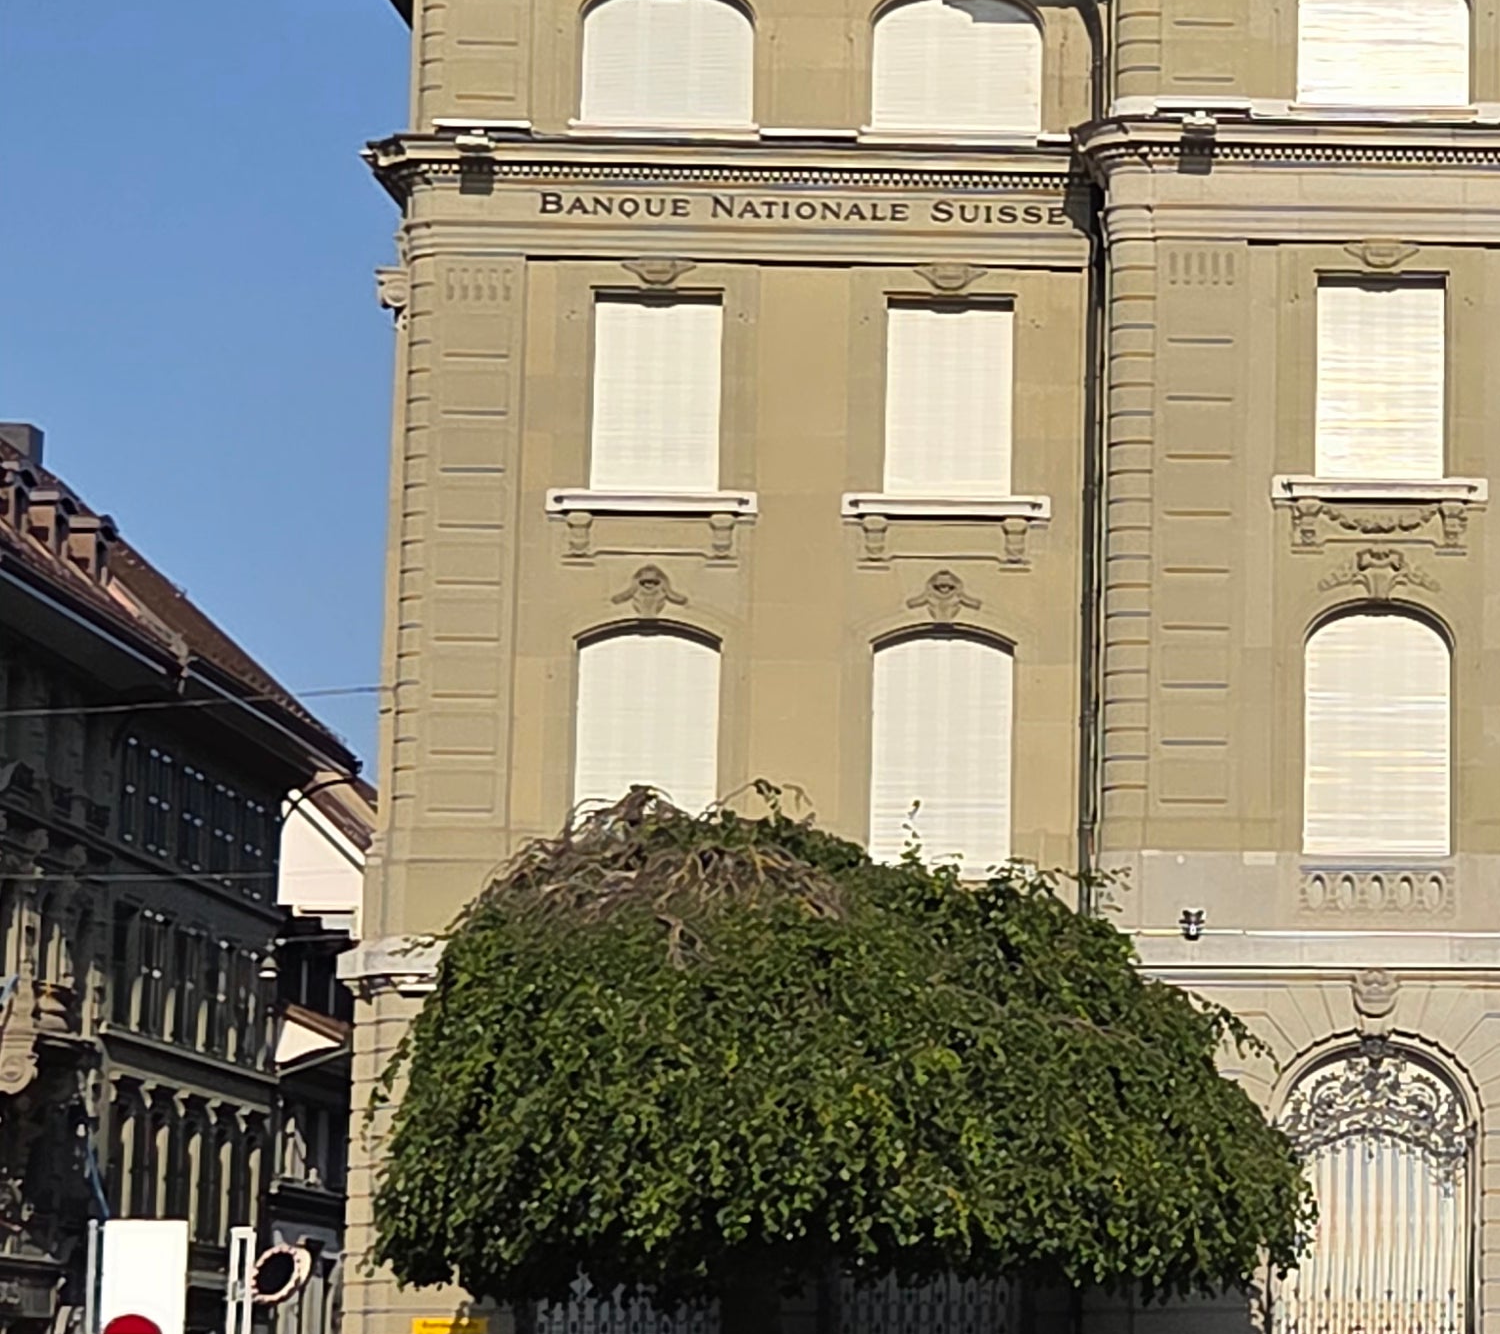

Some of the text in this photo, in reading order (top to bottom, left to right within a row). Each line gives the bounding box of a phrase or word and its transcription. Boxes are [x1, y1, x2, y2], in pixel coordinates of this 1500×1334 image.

[539, 192, 1067, 226] BANQUE NATIONALE SUISSE
